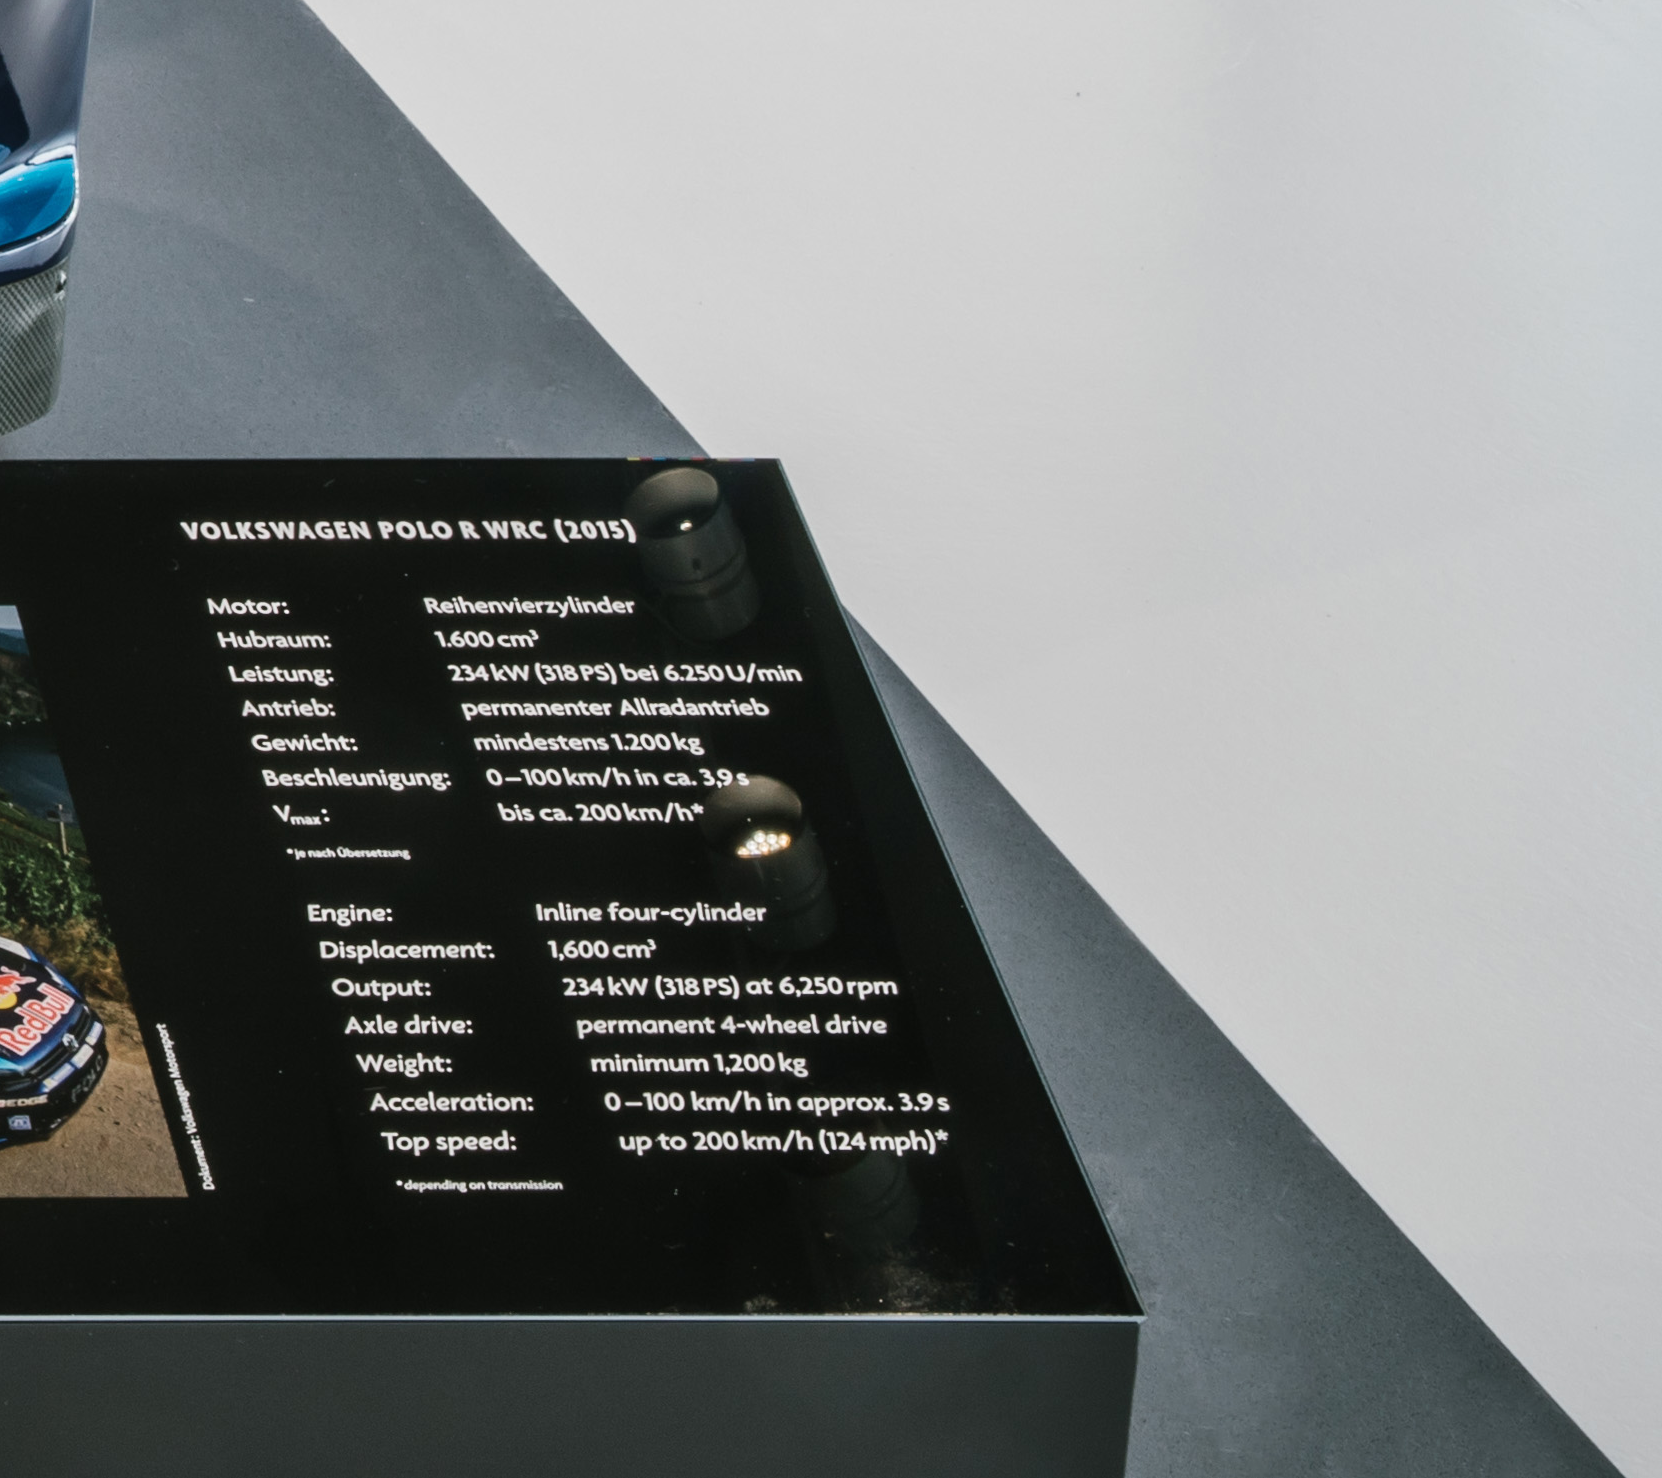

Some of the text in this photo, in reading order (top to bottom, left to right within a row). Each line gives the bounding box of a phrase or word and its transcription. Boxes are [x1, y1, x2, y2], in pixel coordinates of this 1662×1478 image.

[179, 518, 637, 544] VOLKSWAGEN POLO R WRC (2015)
[206, 596, 290, 614] Motor:
[423, 594, 635, 618] Reihenvierzylinder
[216, 629, 332, 649] Hubraum:
[433, 629, 495, 647] 1.600
[241, 697, 336, 717] Antrieb:
[460, 697, 770, 721] permanenter Allradantrieb
[307, 845, 336, 858] nach
[336, 844, 412, 861] Übersetzung
[307, 902, 393, 926] Engine:
[535, 900, 767, 926] Inline four-cylinder
[344, 1013, 474, 1035] Axle drive:
[576, 1013, 888, 1040] permanent 4-wheel drive
[156, 1022, 181, 1079] Motorsport
[173, 1079, 198, 1134] Volkswagen
[468, 1179, 485, 1191] on
[486, 1177, 564, 1191] transmission
